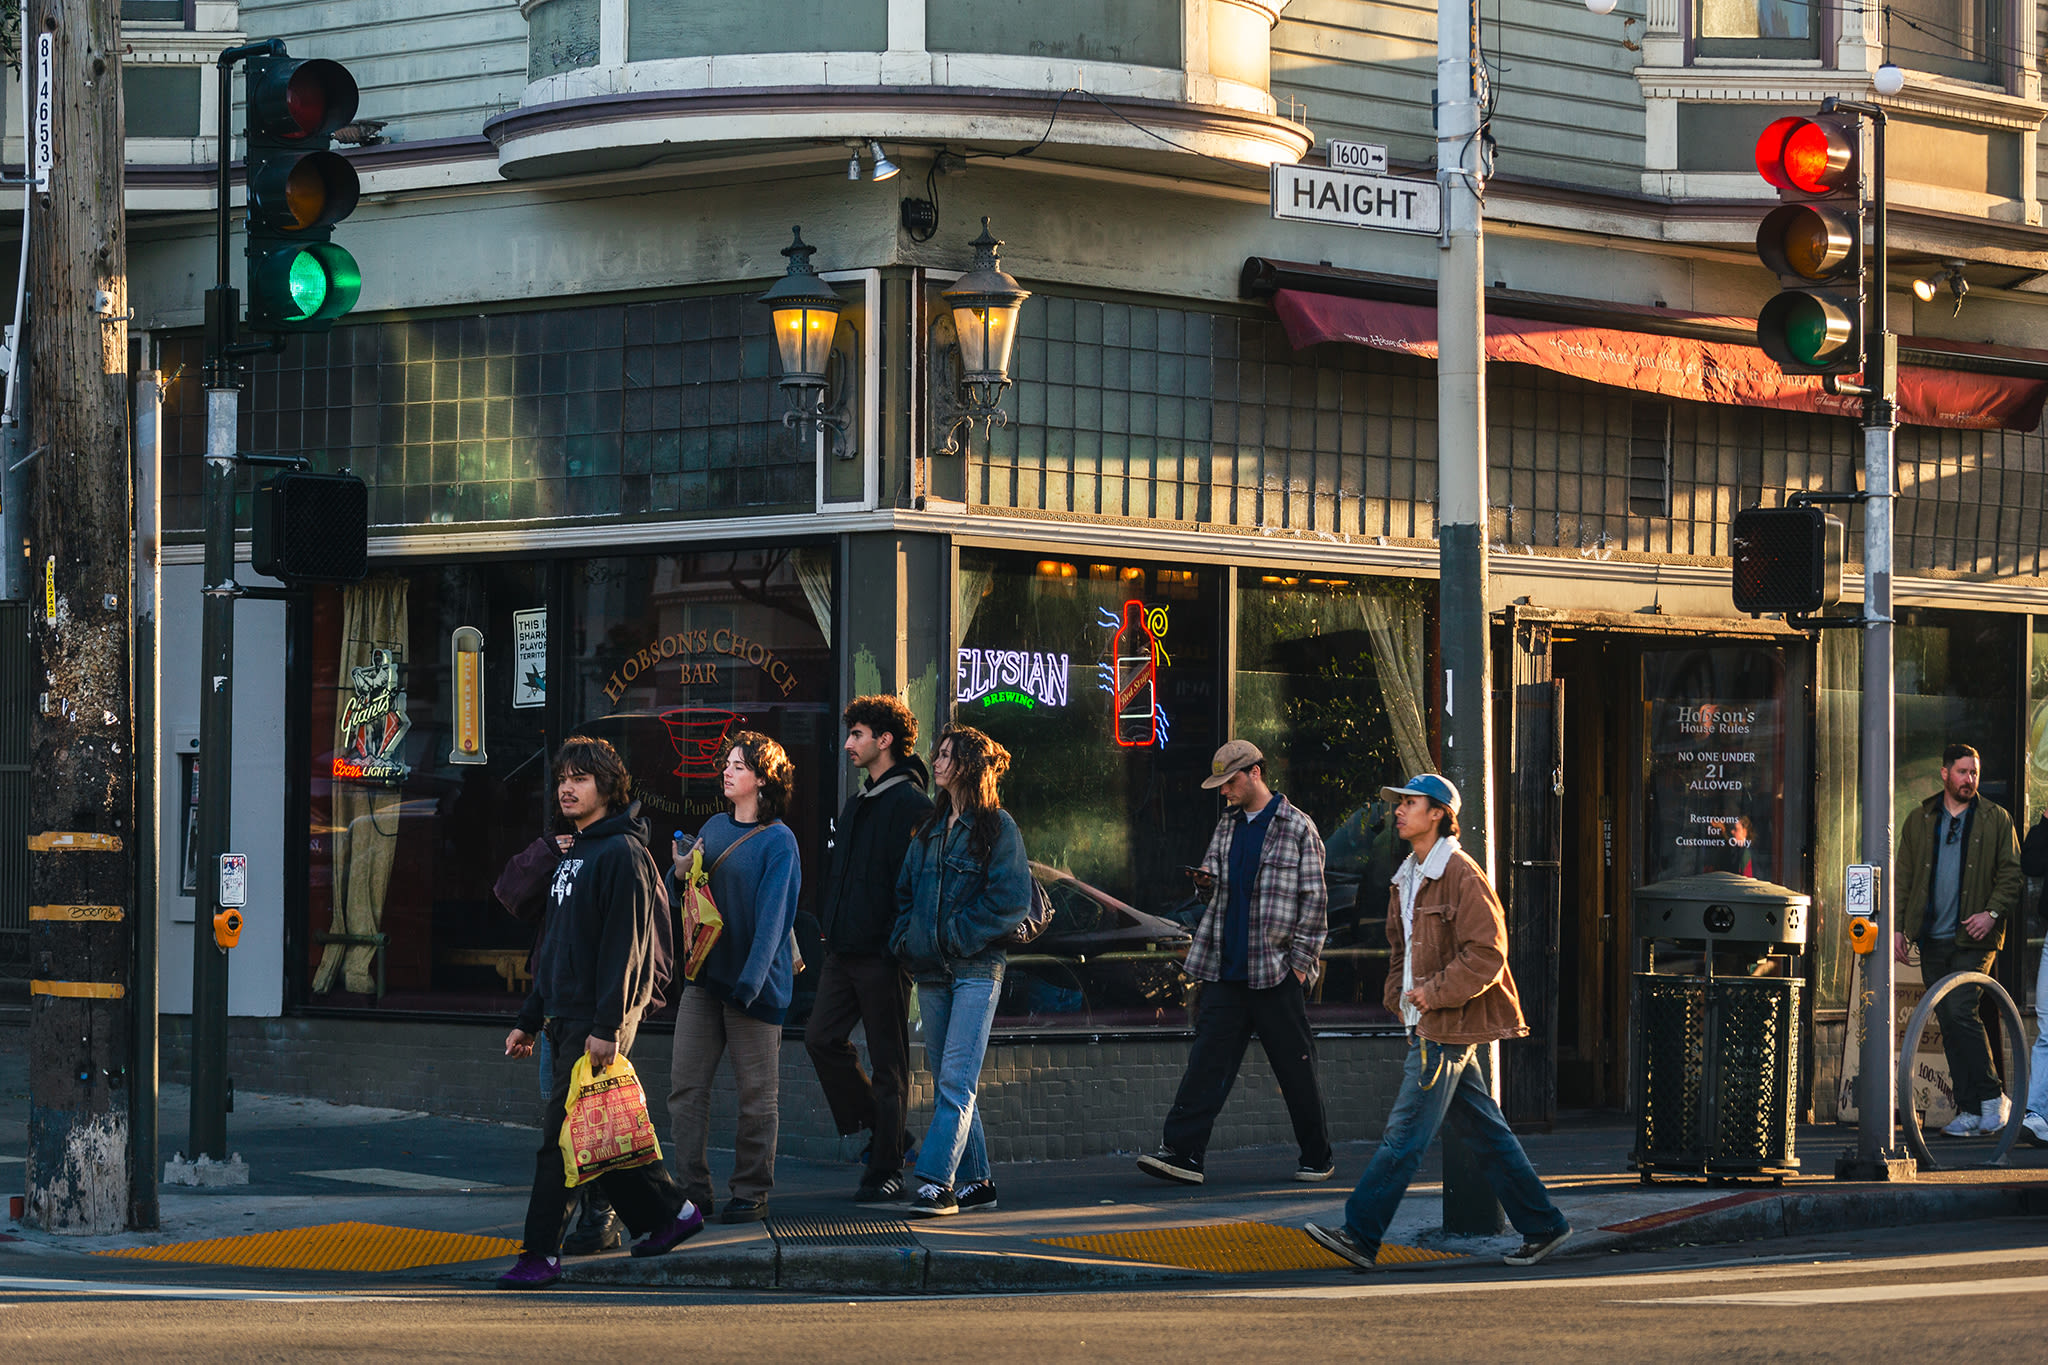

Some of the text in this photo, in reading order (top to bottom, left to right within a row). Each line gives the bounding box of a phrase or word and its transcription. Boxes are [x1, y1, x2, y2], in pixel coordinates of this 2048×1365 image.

[39, 38, 50, 163] 814653
[1336, 144, 1369, 166] 1600
[1293, 177, 1417, 220] HAIGHT
[518, 619, 539, 630] THIS
[519, 630, 546, 642] SHARK
[602, 627, 799, 706] HOBSON'S CHOICE
[679, 663, 720, 685] BAR
[957, 647, 1069, 706] ELYSIAN
[982, 691, 1035, 710] BREWING
[341, 688, 392, 748] Giants
[1677, 706, 1756, 723] Hobson's
[1680, 722, 1750, 734] House Rules
[1678, 751, 1756, 763] NO ONE UNDER
[332, 757, 393, 778] Coors LIGHT
[1705, 764, 1724, 778] 21
[1689, 780, 1743, 791] ALLOWED
[684, 796, 726, 815] Punch
[1690, 814, 1740, 824] Restrooms
[1707, 825, 1722, 836] for
[1675, 836, 1752, 849] Customers Only
[593, 1081, 609, 1090] SELL
[594, 1145, 615, 1160] VINYL
